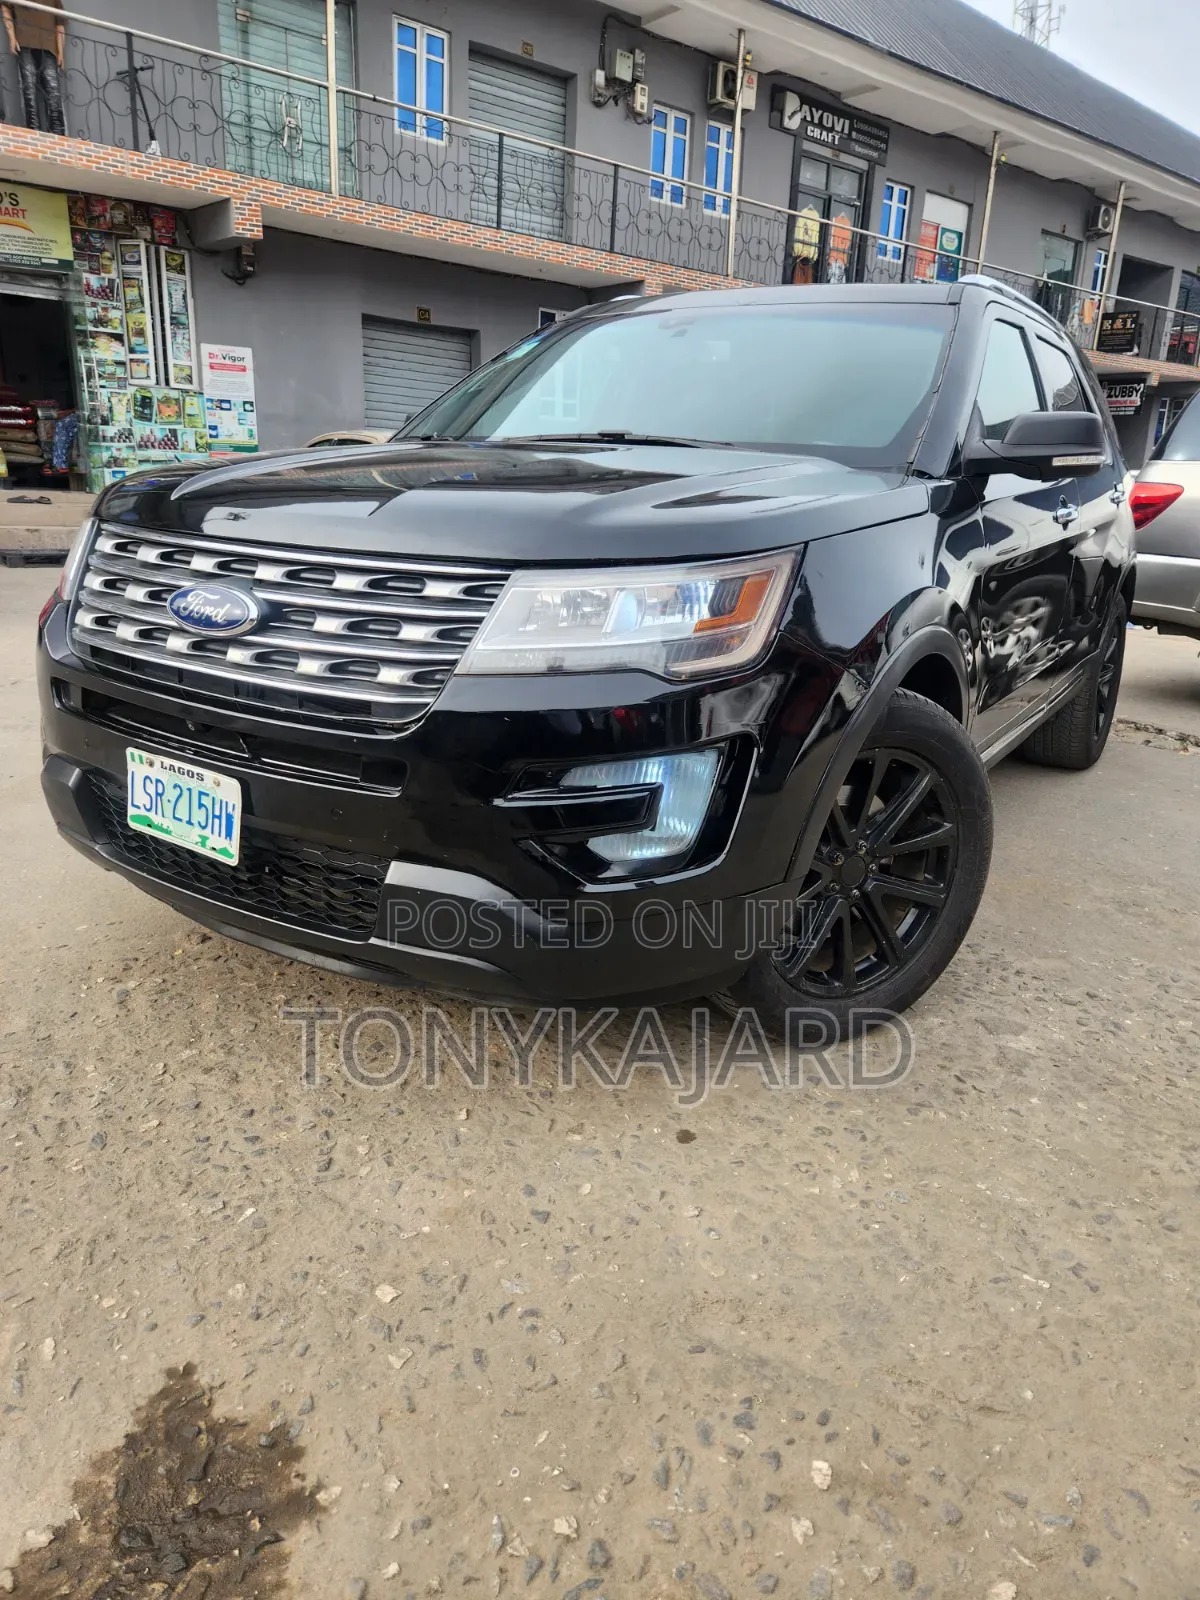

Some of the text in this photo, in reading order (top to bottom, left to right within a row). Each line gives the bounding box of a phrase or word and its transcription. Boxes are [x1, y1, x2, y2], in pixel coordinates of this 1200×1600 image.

[806, 125, 840, 145] CRAFT
[419, 310, 429, 319] C4
[1106, 384, 1143, 399] ZUBBY
[180, 590, 227, 624] Ford
[159, 760, 205, 782] LAGOS
